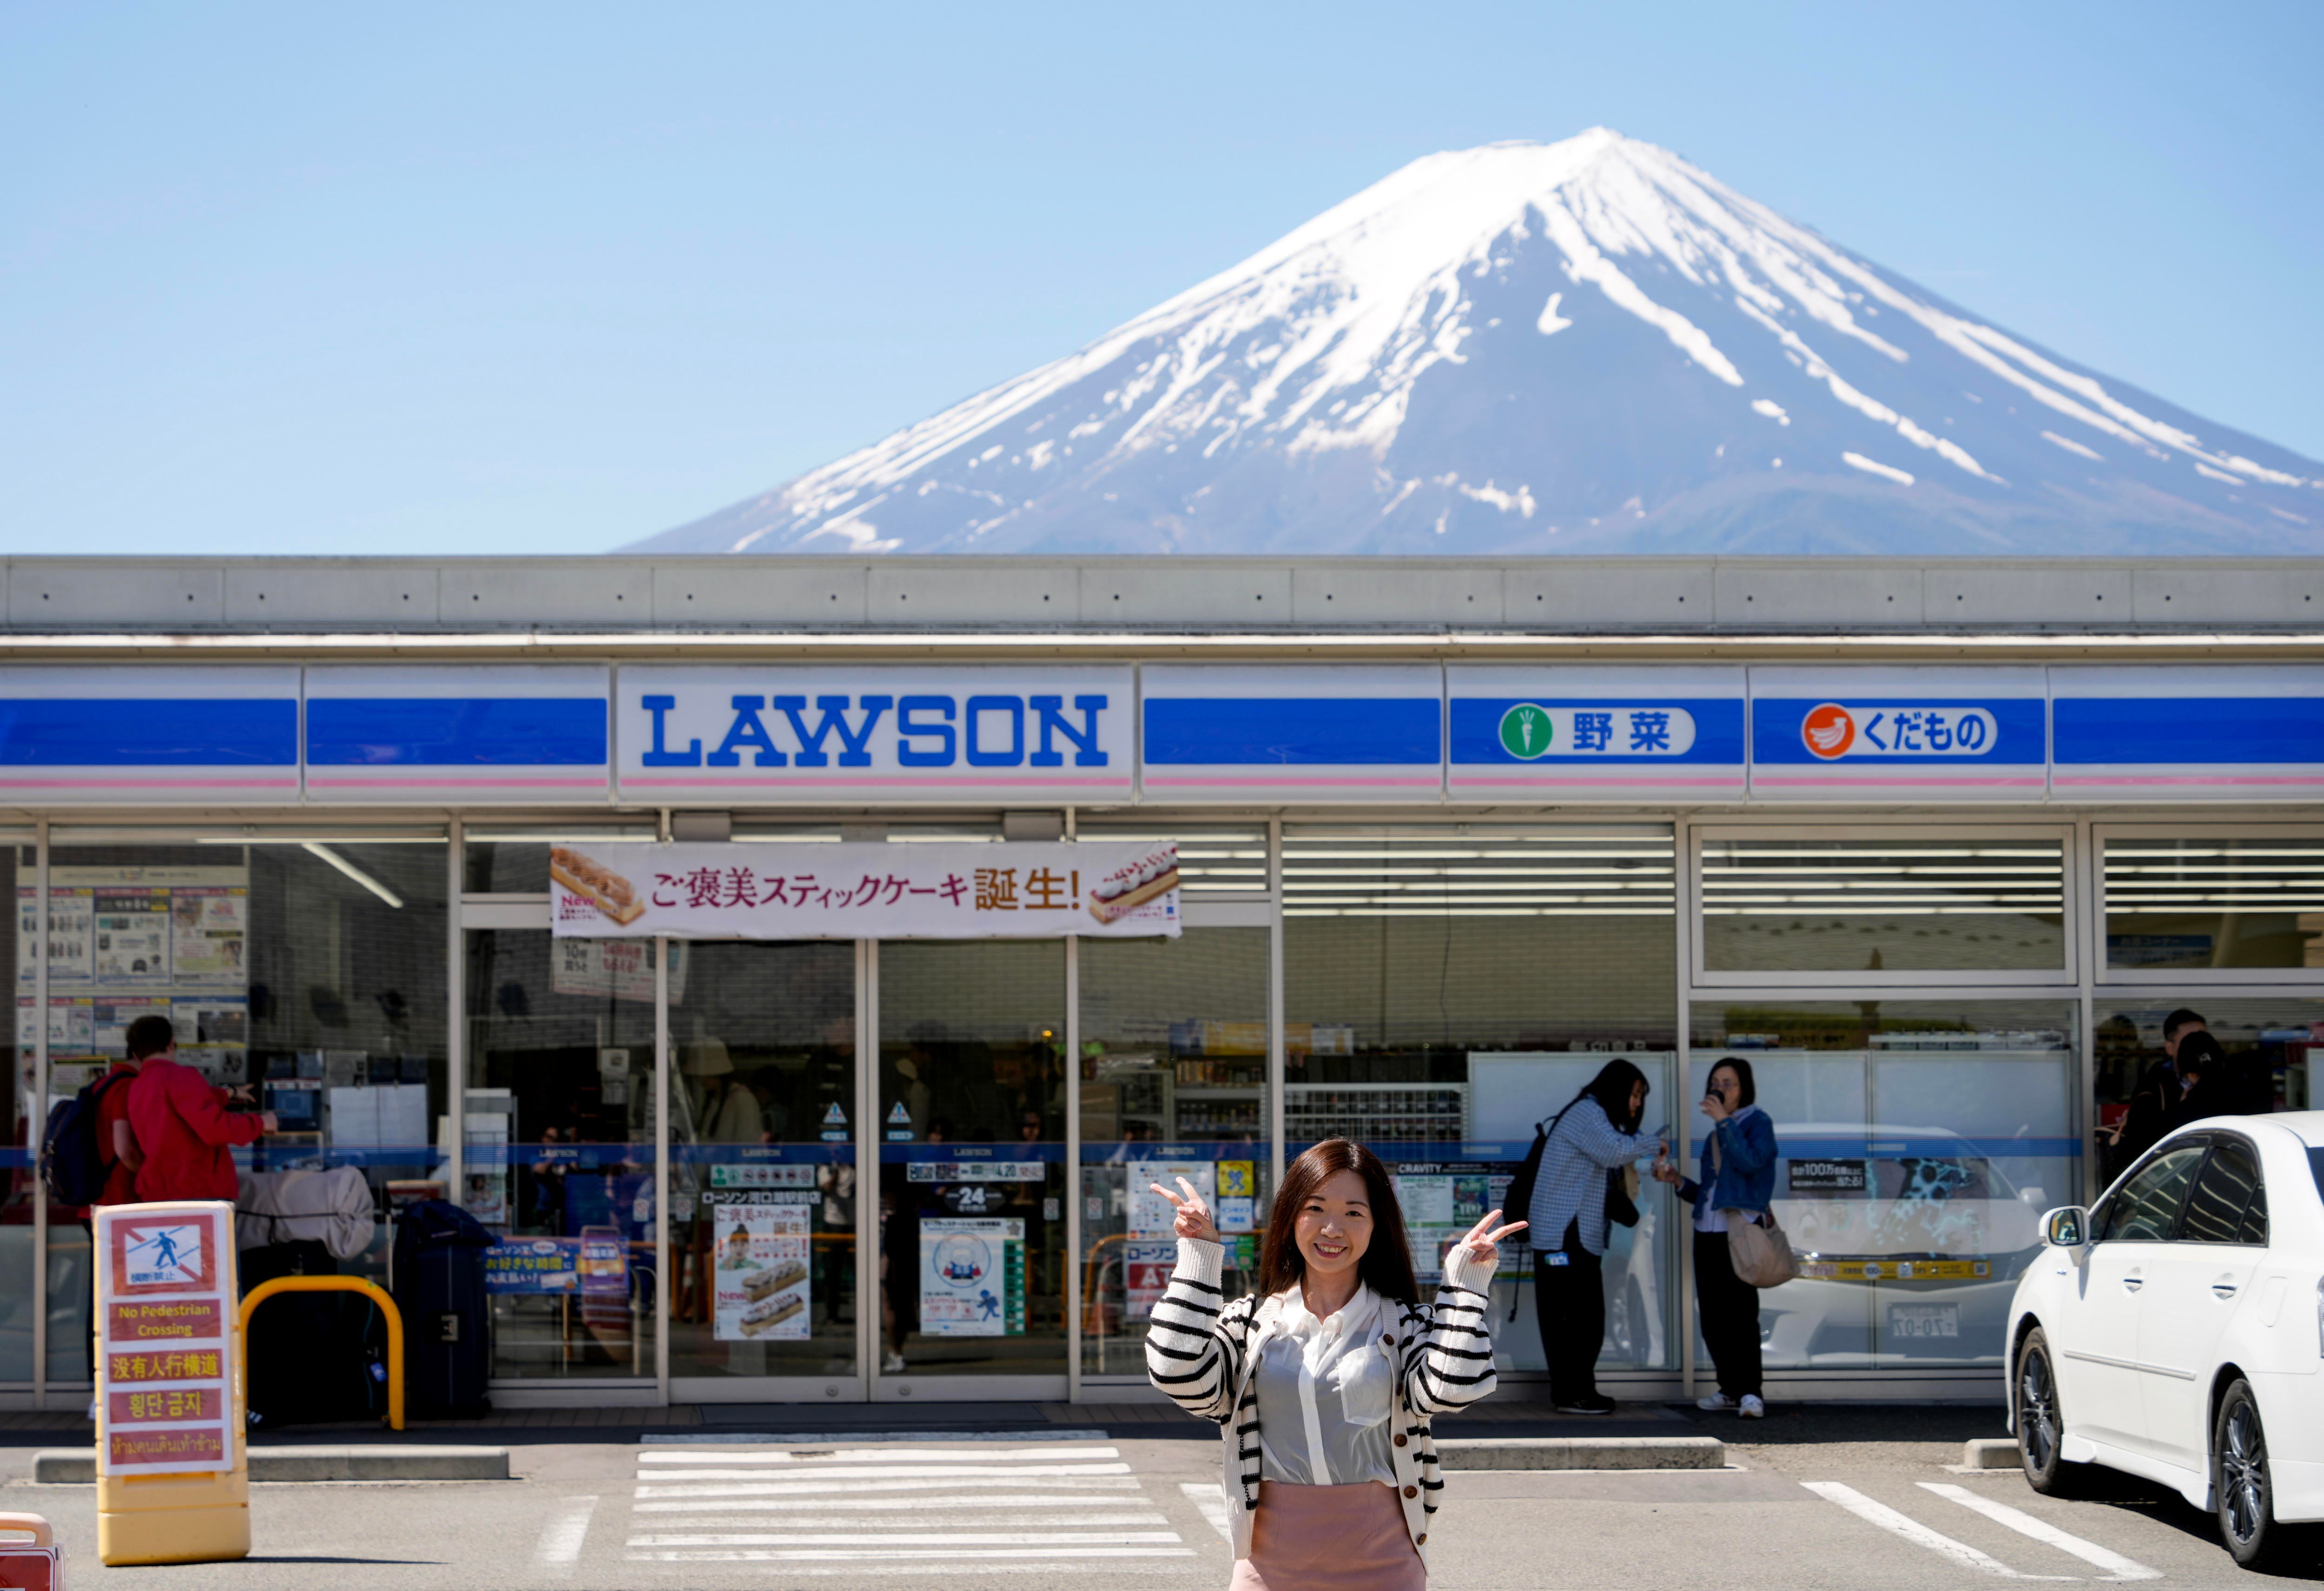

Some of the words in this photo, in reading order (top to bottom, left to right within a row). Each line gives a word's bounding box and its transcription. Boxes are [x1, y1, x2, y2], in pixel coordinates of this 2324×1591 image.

[642, 695, 1108, 767] LAWSON
[1573, 711, 1670, 752] 野菜
[1864, 711, 1986, 751] くだもの
[561, 895, 595, 906] New
[1398, 1163, 1442, 1174] CRAVITY
[958, 1186, 986, 1205] 24
[1128, 1248, 1178, 1260] ローソン
[131, 1271, 175, 1282] 横断禁止
[1140, 1267, 1172, 1287] AT
[119, 1306, 138, 1319] No
[141, 1303, 211, 1318] Pedestrian
[138, 1322, 193, 1337] Crossing
[113, 1353, 218, 1380] 没有人行横道
[129, 1393, 164, 1419] 횡단
[168, 1391, 202, 1417] 금지
